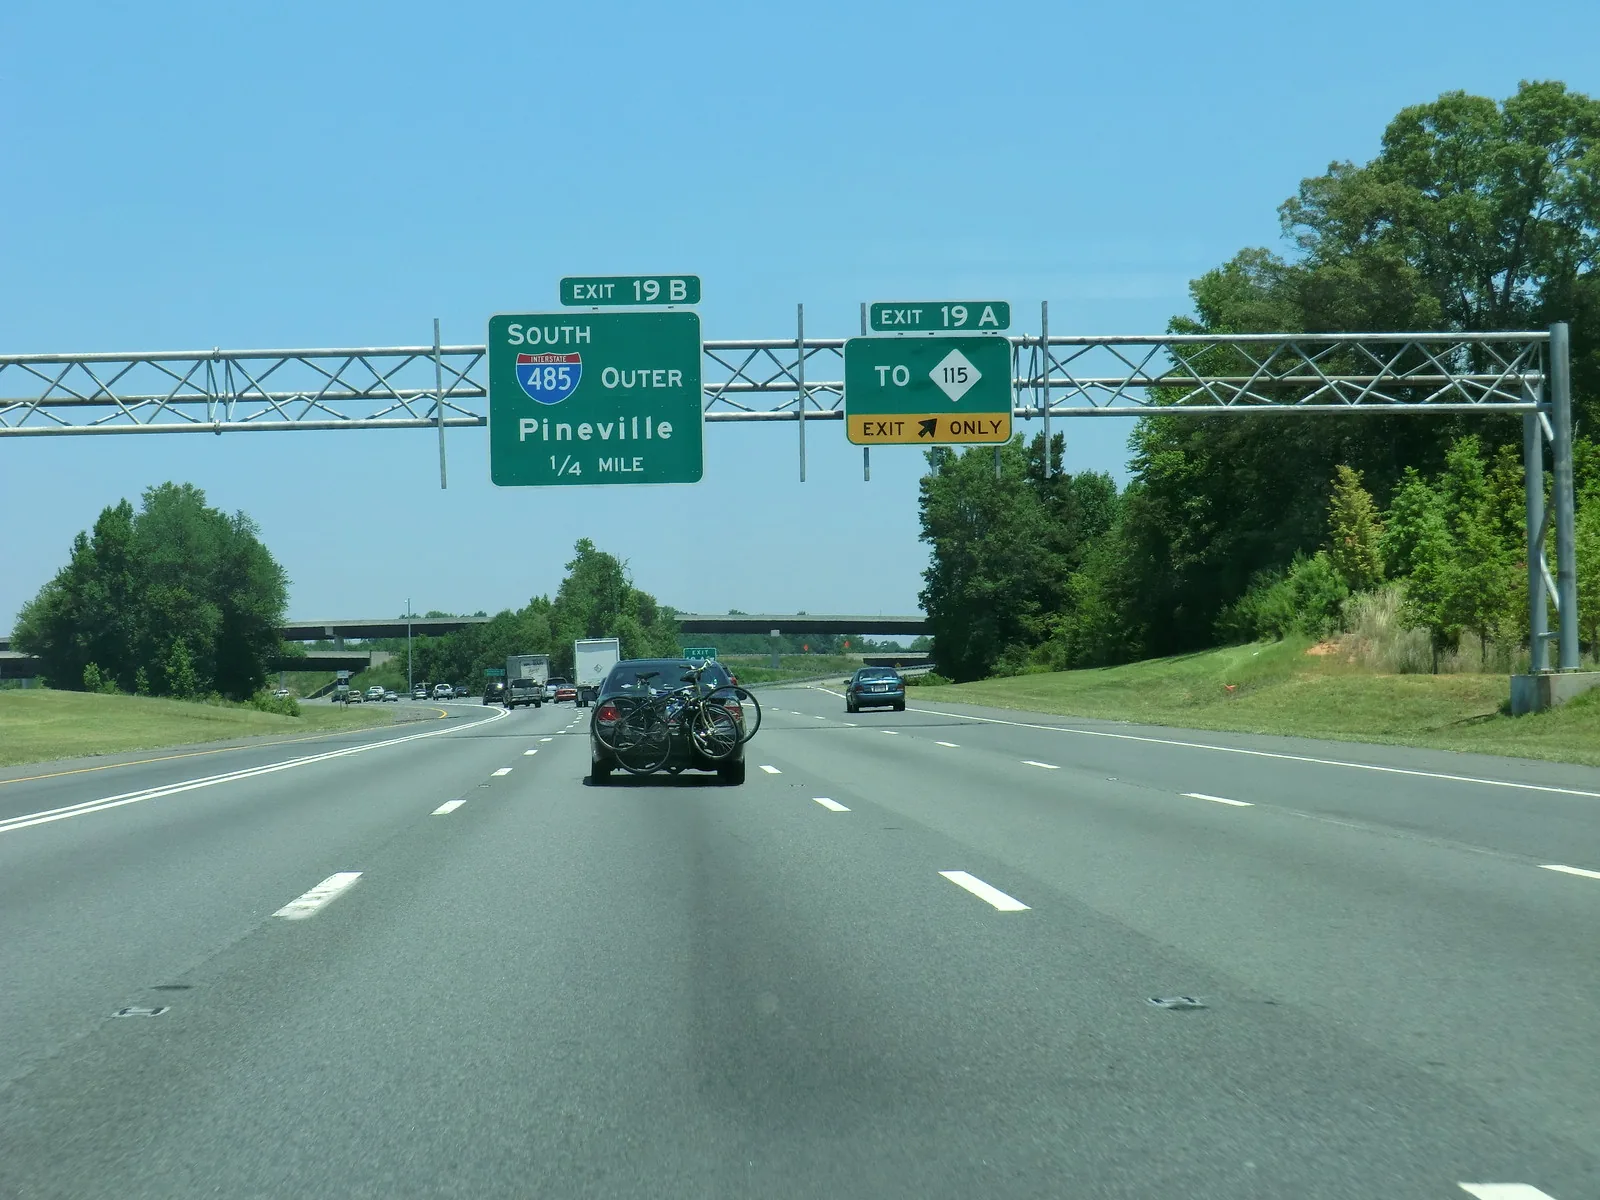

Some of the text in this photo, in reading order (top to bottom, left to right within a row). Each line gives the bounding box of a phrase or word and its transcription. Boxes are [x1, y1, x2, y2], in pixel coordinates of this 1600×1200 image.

[573, 279, 687, 301] EXIT 19 B
[881, 305, 999, 327] EXIT 19 A
[507, 323, 591, 345] SOUTH
[531, 355, 567, 363] INTERSTATE
[527, 367, 571, 391] 485
[602, 366, 683, 389] OUTER
[874, 365, 968, 387] TO 115
[519, 416, 673, 442] Pineville
[863, 420, 1003, 436] EXIT ONLY
[550, 454, 644, 477] 1/4 MILE
